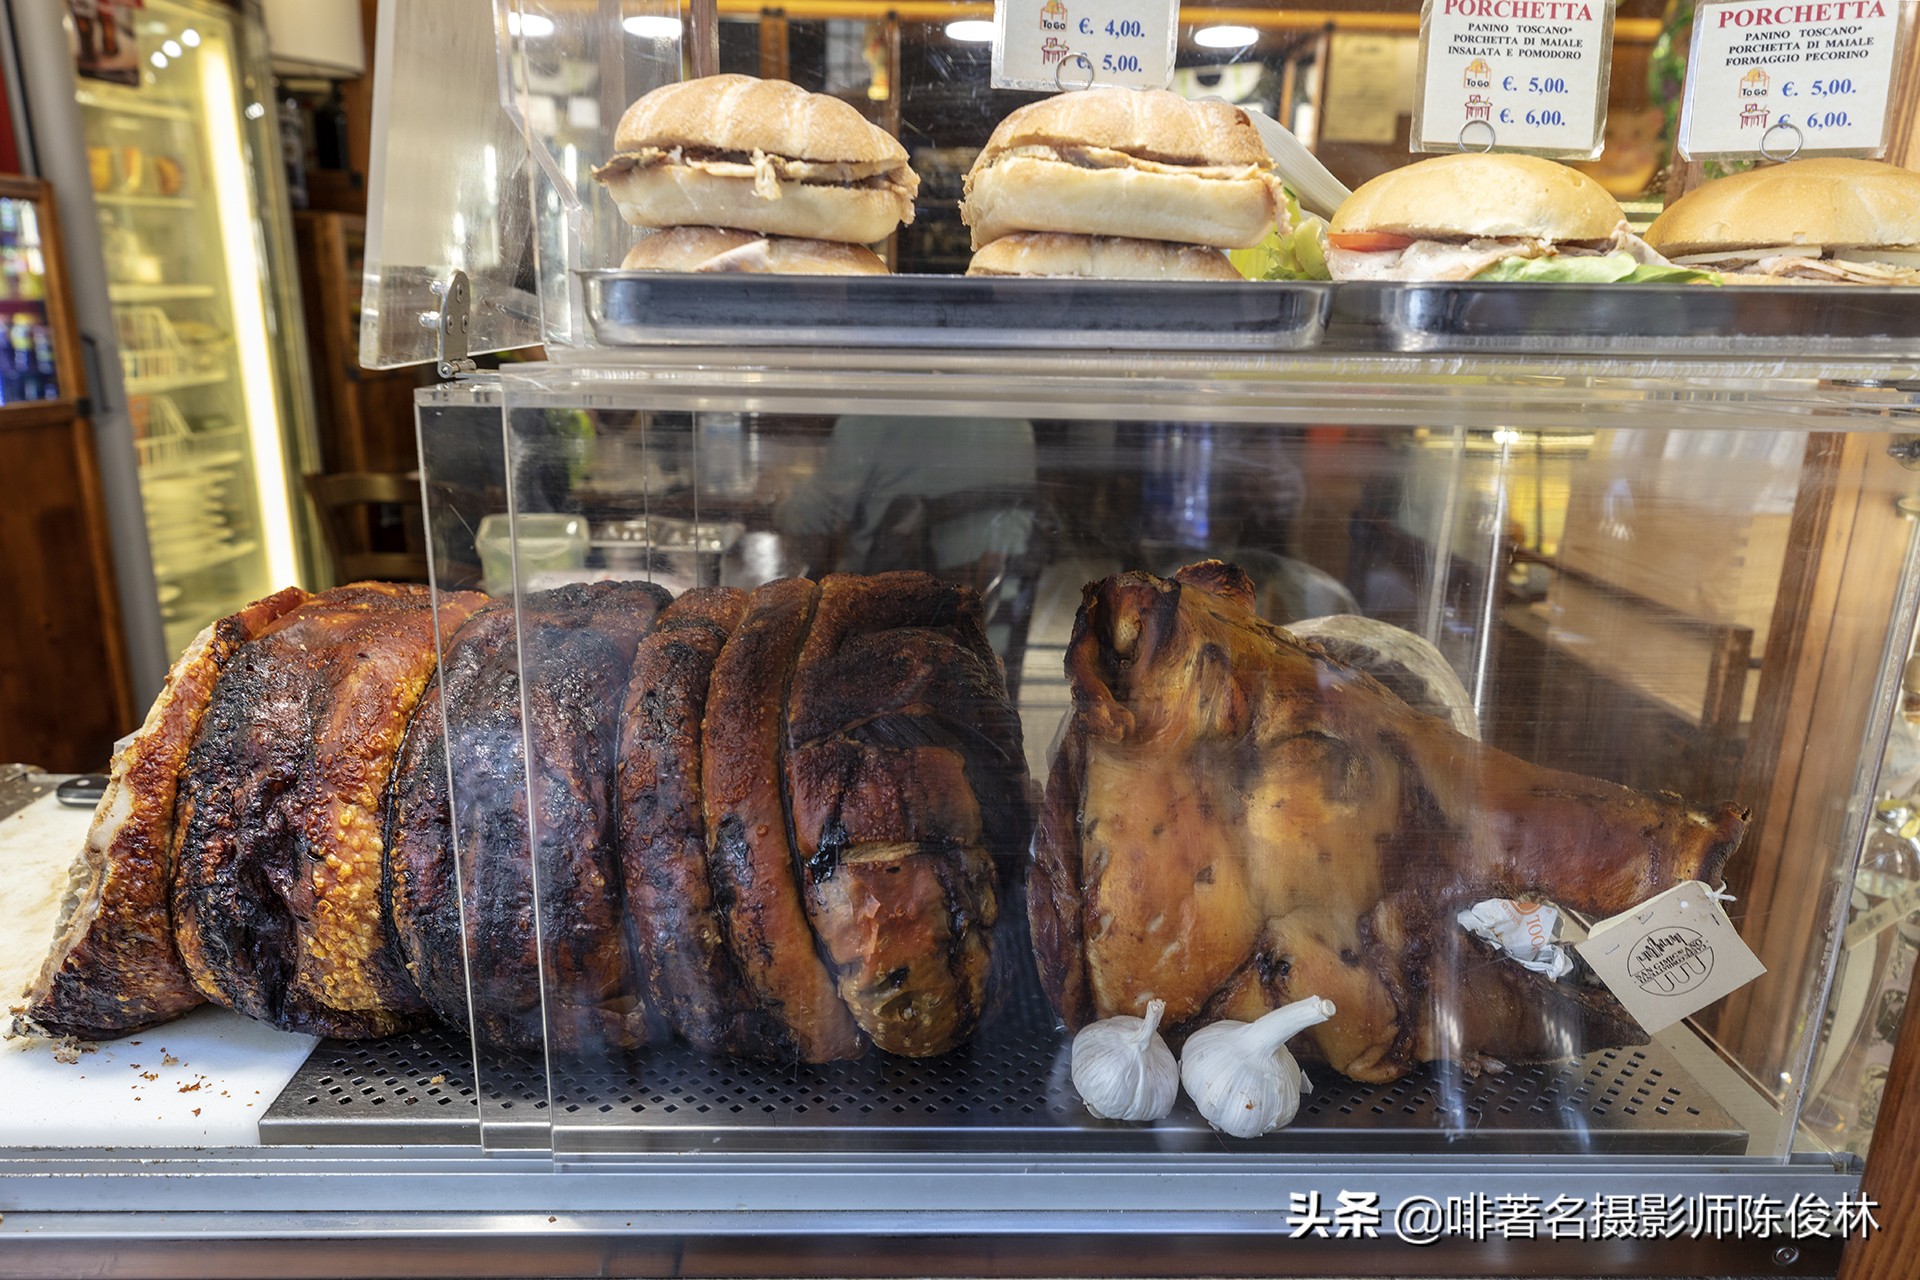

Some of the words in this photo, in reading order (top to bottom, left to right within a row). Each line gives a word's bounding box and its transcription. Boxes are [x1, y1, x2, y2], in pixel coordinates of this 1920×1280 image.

[1443, 0, 1593, 21] PORCHETTA
[1718, 0, 1886, 28] PORCHETTA
[1104, 19, 1145, 38] 4,00.
[1468, 23, 1509, 33] PANINO
[1745, 30, 1790, 41] PANINO
[1454, 34, 1518, 45] PORCHETTA
[1524, 37, 1535, 46] DI
[1540, 38, 1584, 48] MAIALE
[1728, 42, 1800, 54] PORCHETTA
[1806, 40, 1820, 49] DI
[1825, 37, 1875, 48] MAIALE
[1448, 46, 1501, 56] INSALATA
[1506, 48, 1513, 56] E
[1518, 49, 1582, 60] POMODORO
[1725, 54, 1800, 67] FORMAGGIO
[1805, 49, 1869, 62] PECORINO
[1102, 54, 1142, 73] 5,00.
[1528, 77, 1569, 95] 5,00.
[1811, 78, 1856, 98] 5,00.
[1525, 110, 1566, 128] 6,00.
[1807, 111, 1852, 130] 6,00.
[1635, 966, 1653, 982] SAN
